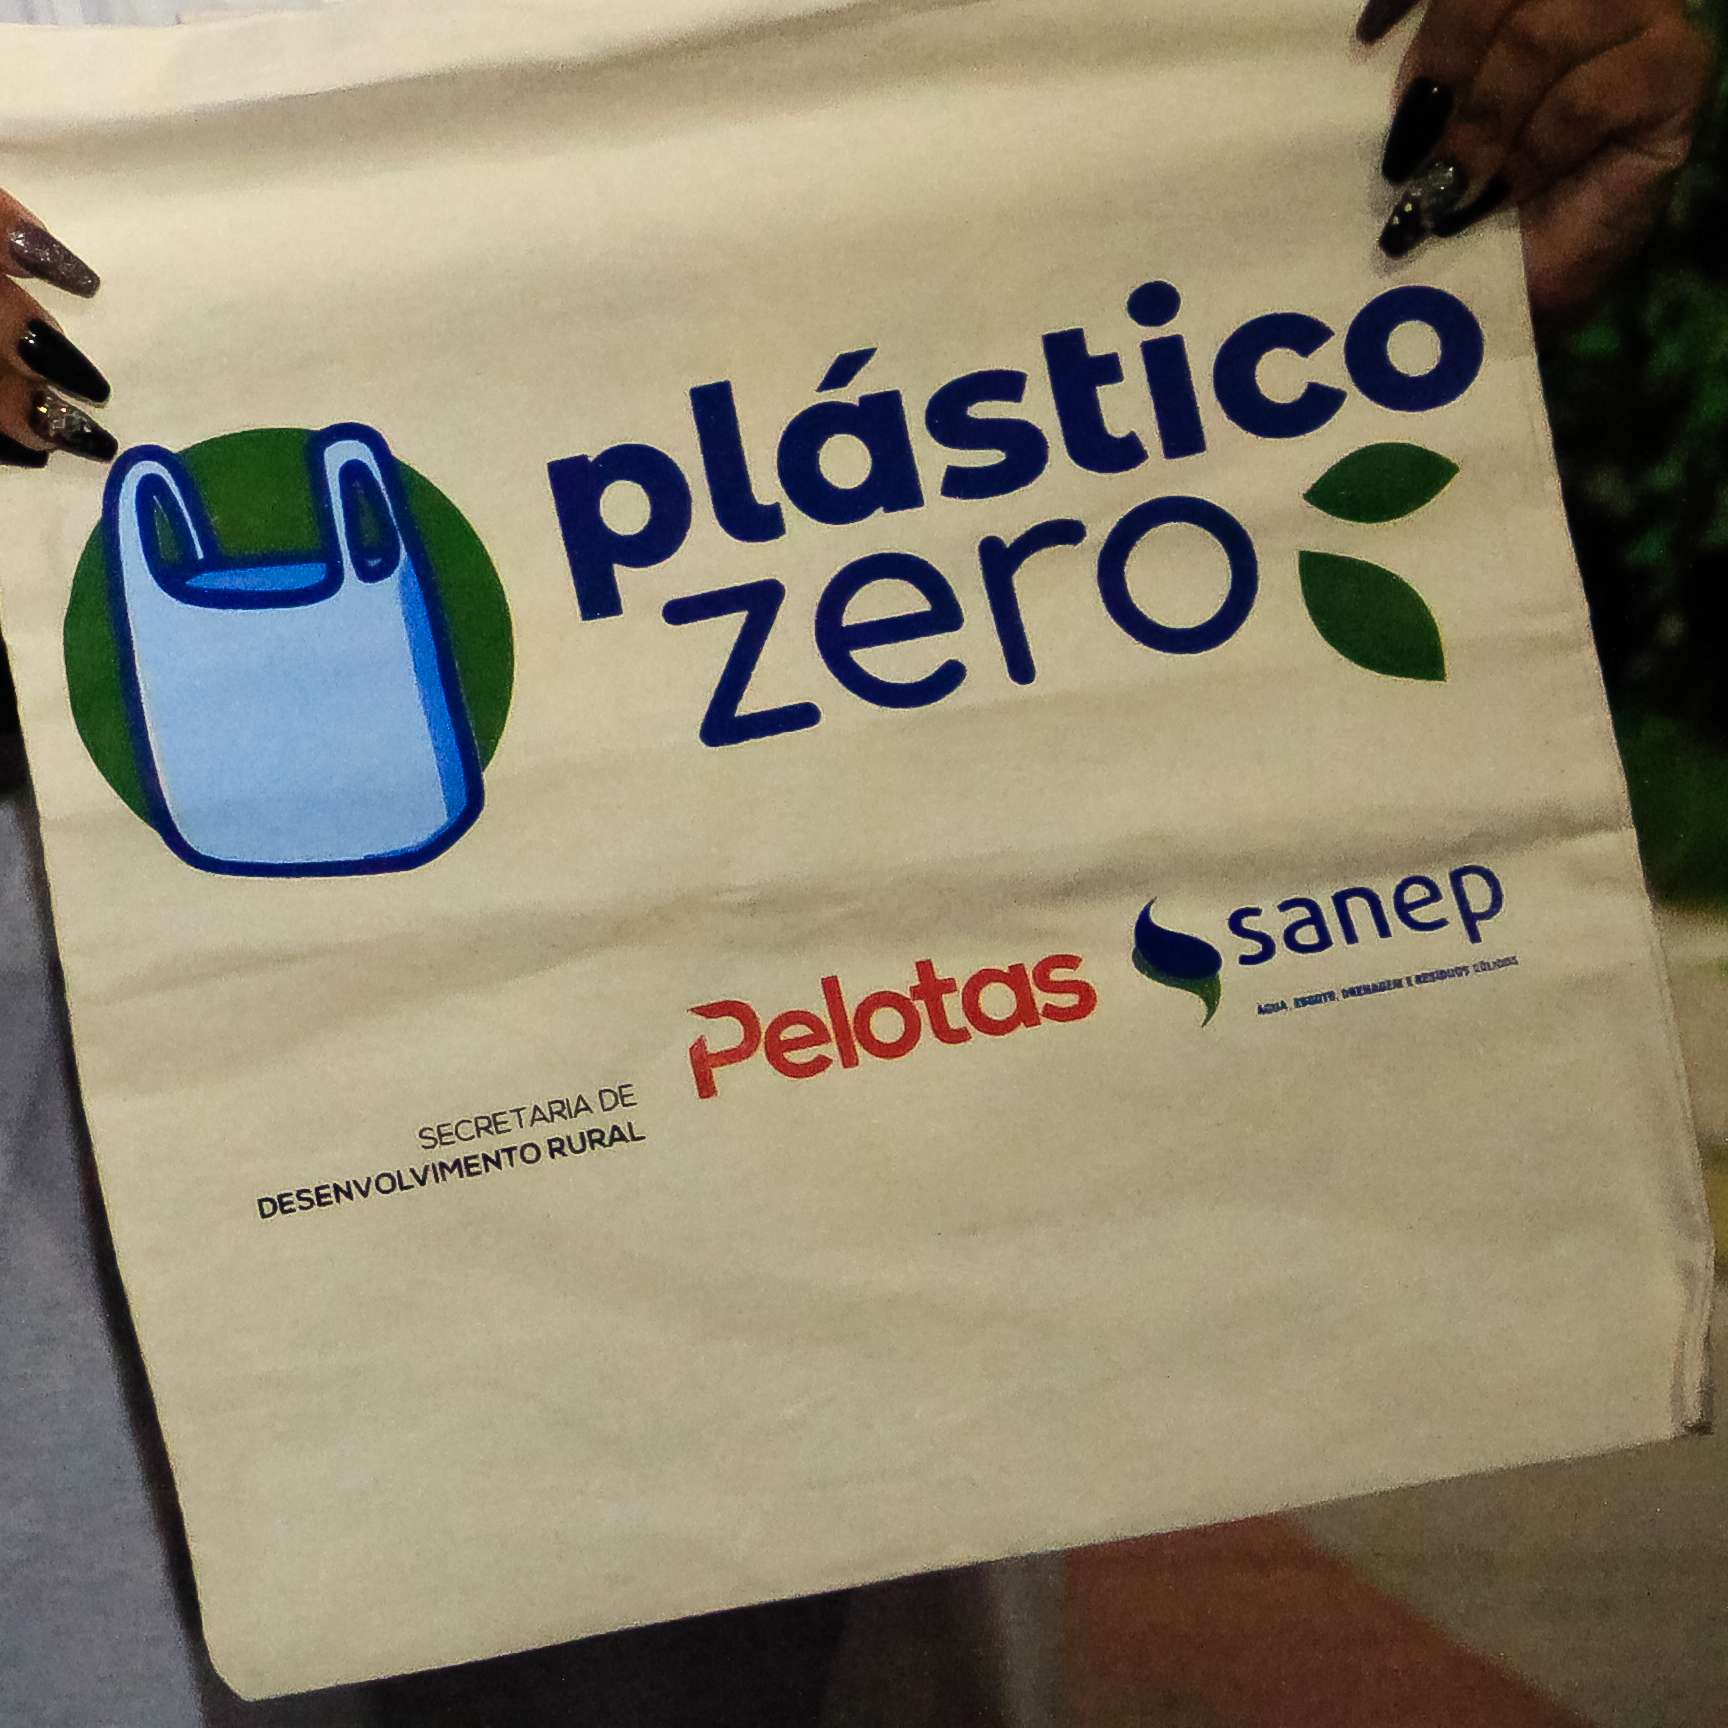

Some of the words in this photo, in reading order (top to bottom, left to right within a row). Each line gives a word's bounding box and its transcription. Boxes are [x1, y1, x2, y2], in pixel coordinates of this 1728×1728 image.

[547, 280, 1484, 621] plástico
[662, 495, 1258, 748] zero
[1227, 864, 1505, 966] sanep
[689, 953, 1098, 1099] Pelotas
[256, 1141, 542, 1220] DESENVOLVIMENTO
[547, 1122, 647, 1160] RURAL
[418, 1093, 594, 1150] SECRETARIA
[597, 1083, 639, 1113] DE
